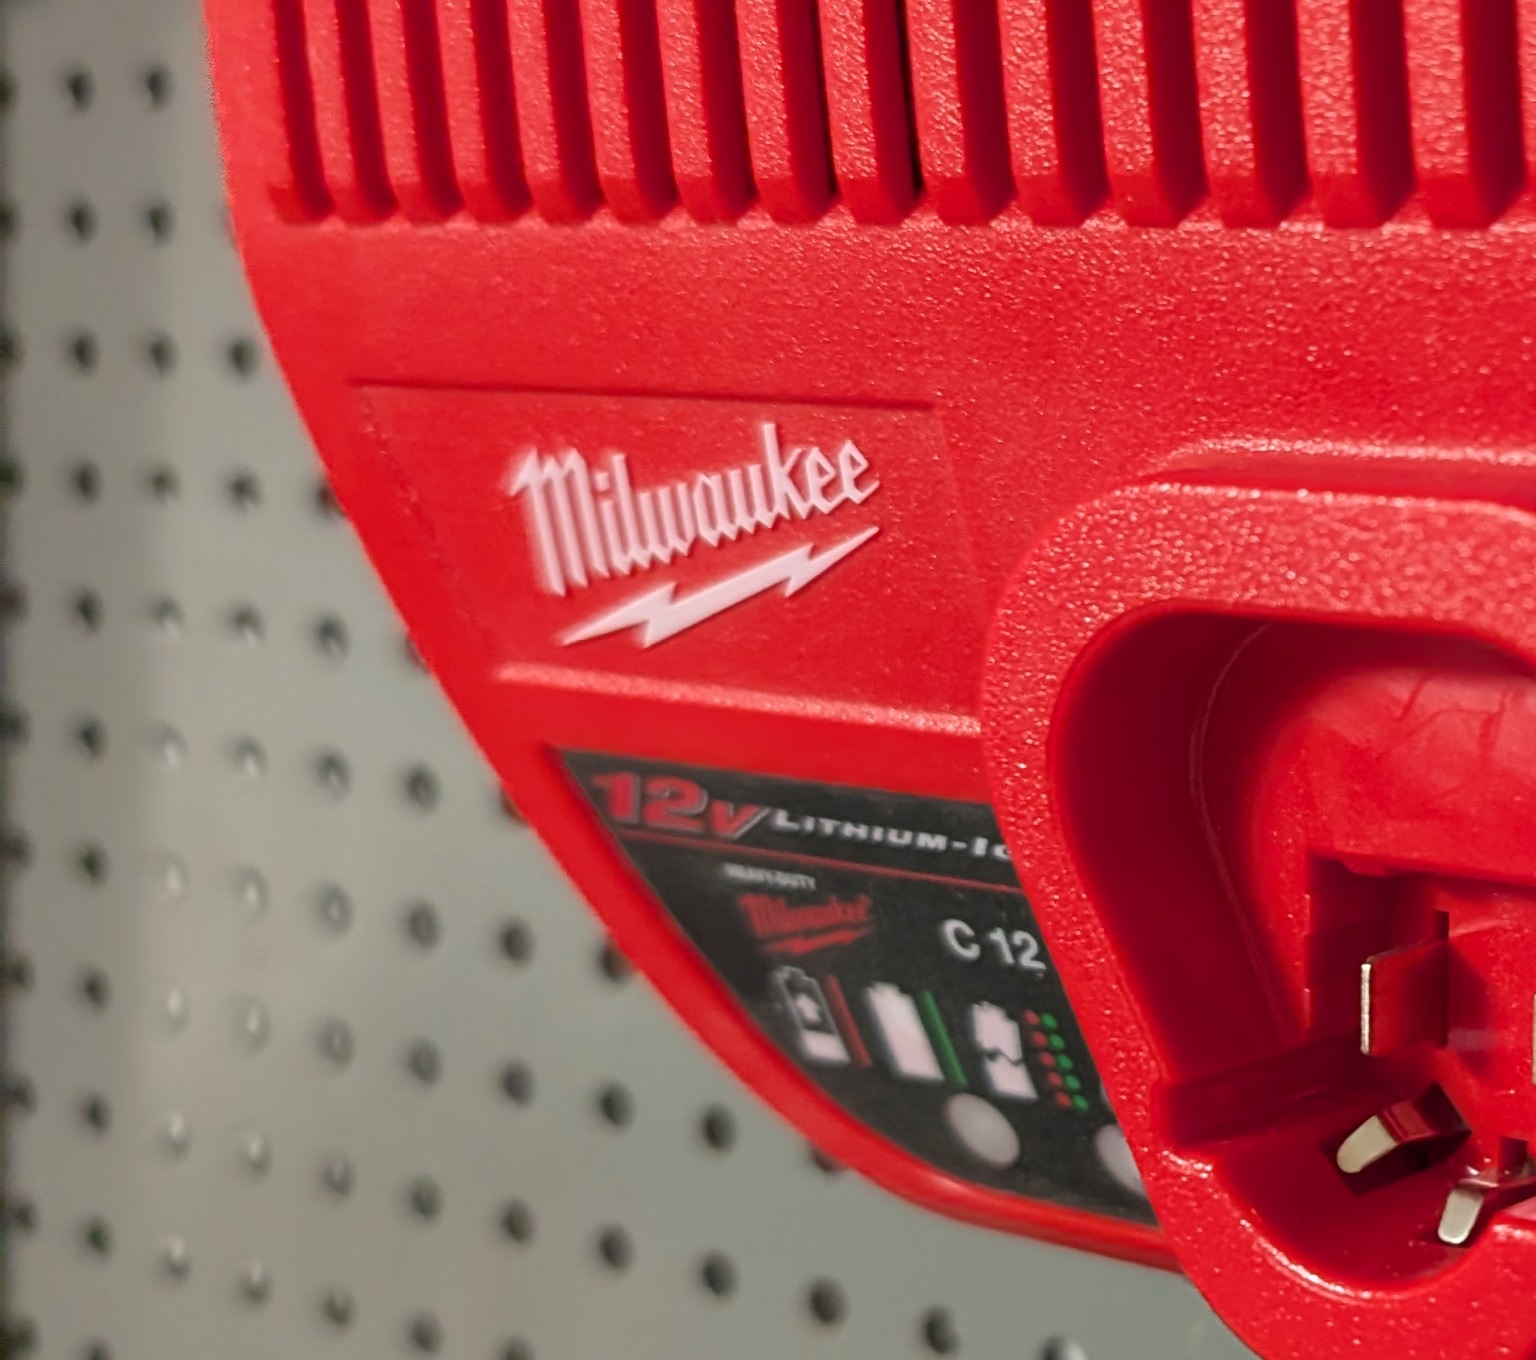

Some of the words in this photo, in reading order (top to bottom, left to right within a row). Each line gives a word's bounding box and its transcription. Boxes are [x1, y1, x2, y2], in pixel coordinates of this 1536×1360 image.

[509, 422, 882, 598] Milwaukee
[771, 808, 1012, 861] LITHIUM-IO
[942, 918, 982, 962] C
[988, 926, 1047, 971] 12
